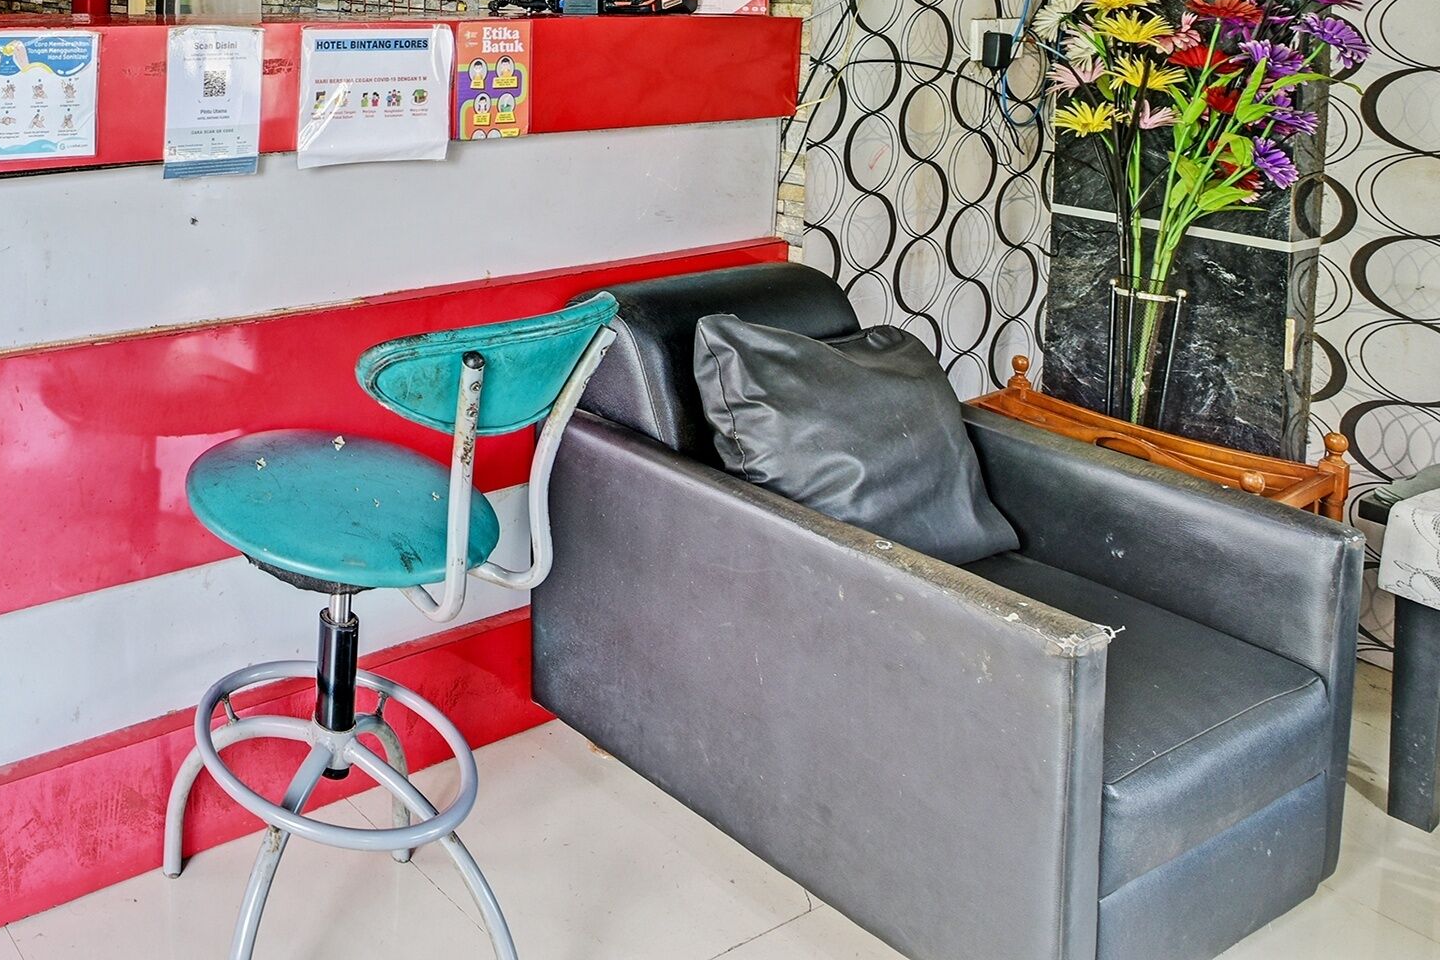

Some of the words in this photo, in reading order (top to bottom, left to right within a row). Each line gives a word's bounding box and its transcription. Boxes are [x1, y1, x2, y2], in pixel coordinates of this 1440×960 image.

[483, 27, 520, 40] Etika
[194, 42, 213, 50] Scan
[216, 41, 237, 50] Disini
[316, 41, 348, 50] HOTEL
[350, 40, 391, 49] BINTANG
[394, 40, 428, 48] FLORES
[482, 40, 524, 53] Batuk
